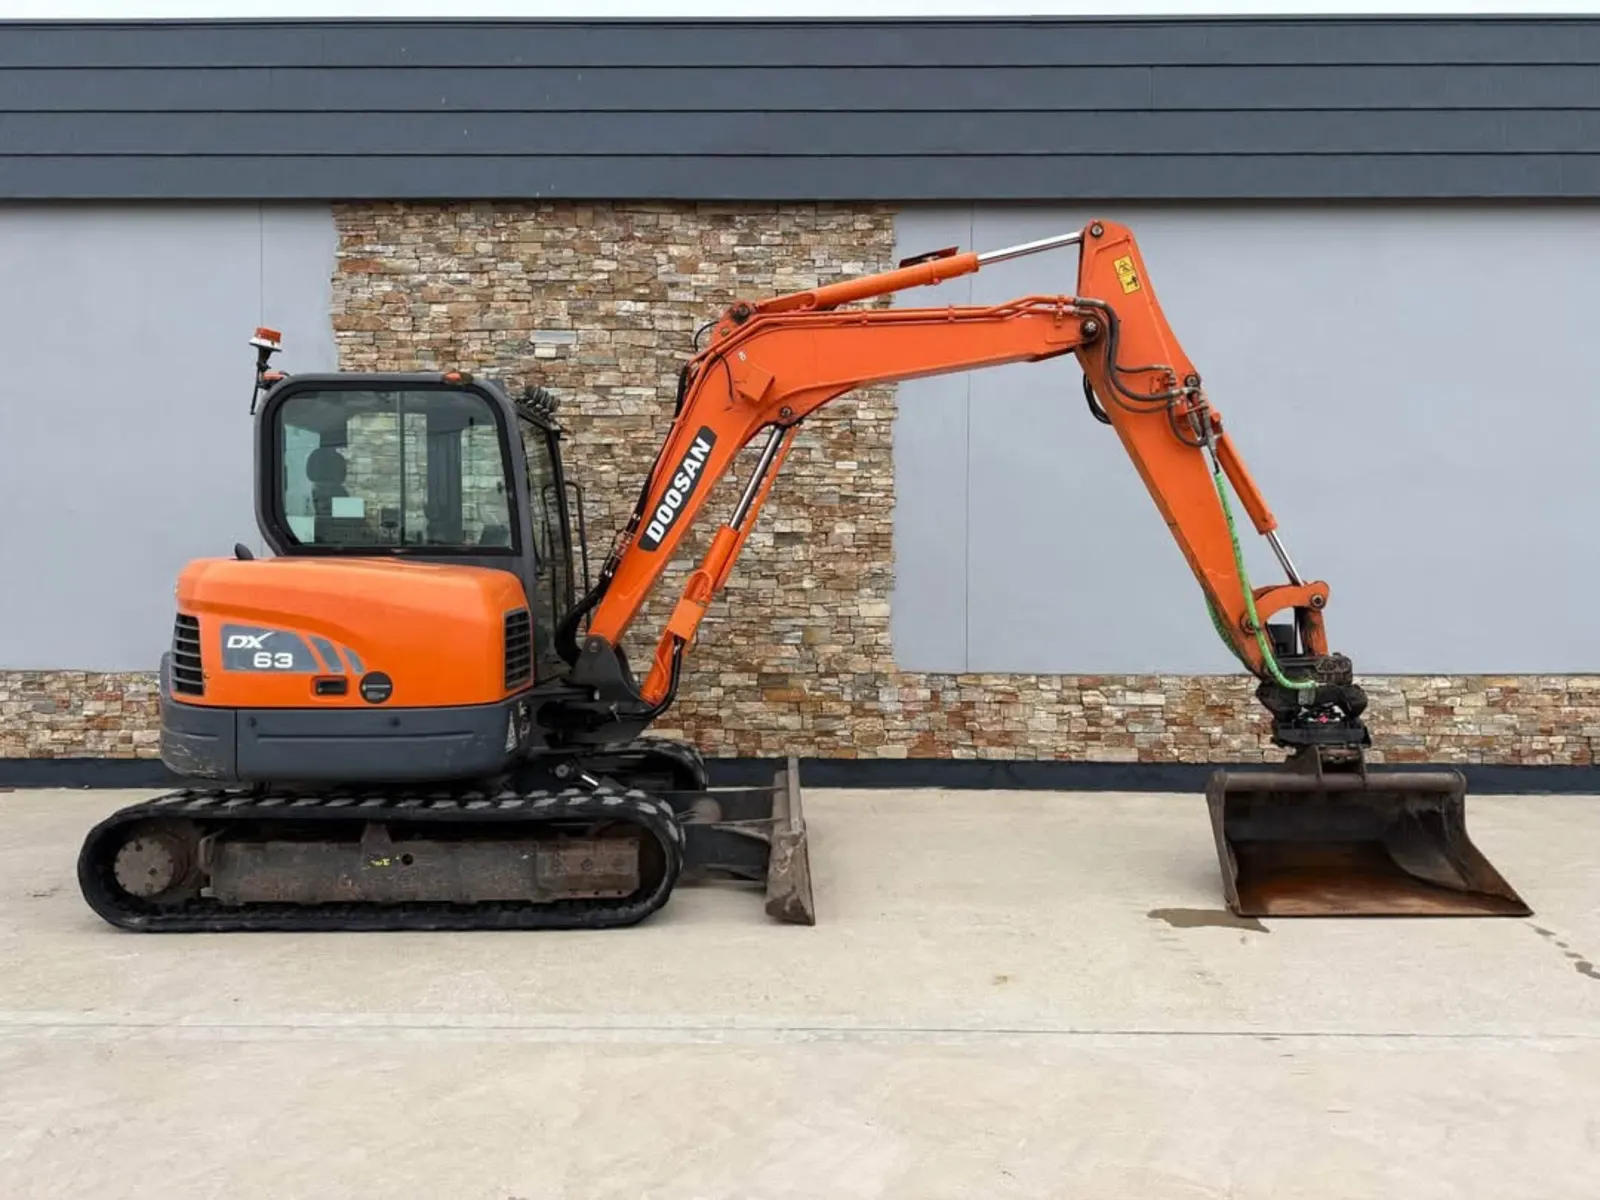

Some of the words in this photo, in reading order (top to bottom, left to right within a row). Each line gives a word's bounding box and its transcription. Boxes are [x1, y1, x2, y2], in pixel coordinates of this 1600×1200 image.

[645, 436, 711, 543] DOOSAN
[226, 631, 276, 649] DX
[253, 652, 293, 669] 63
